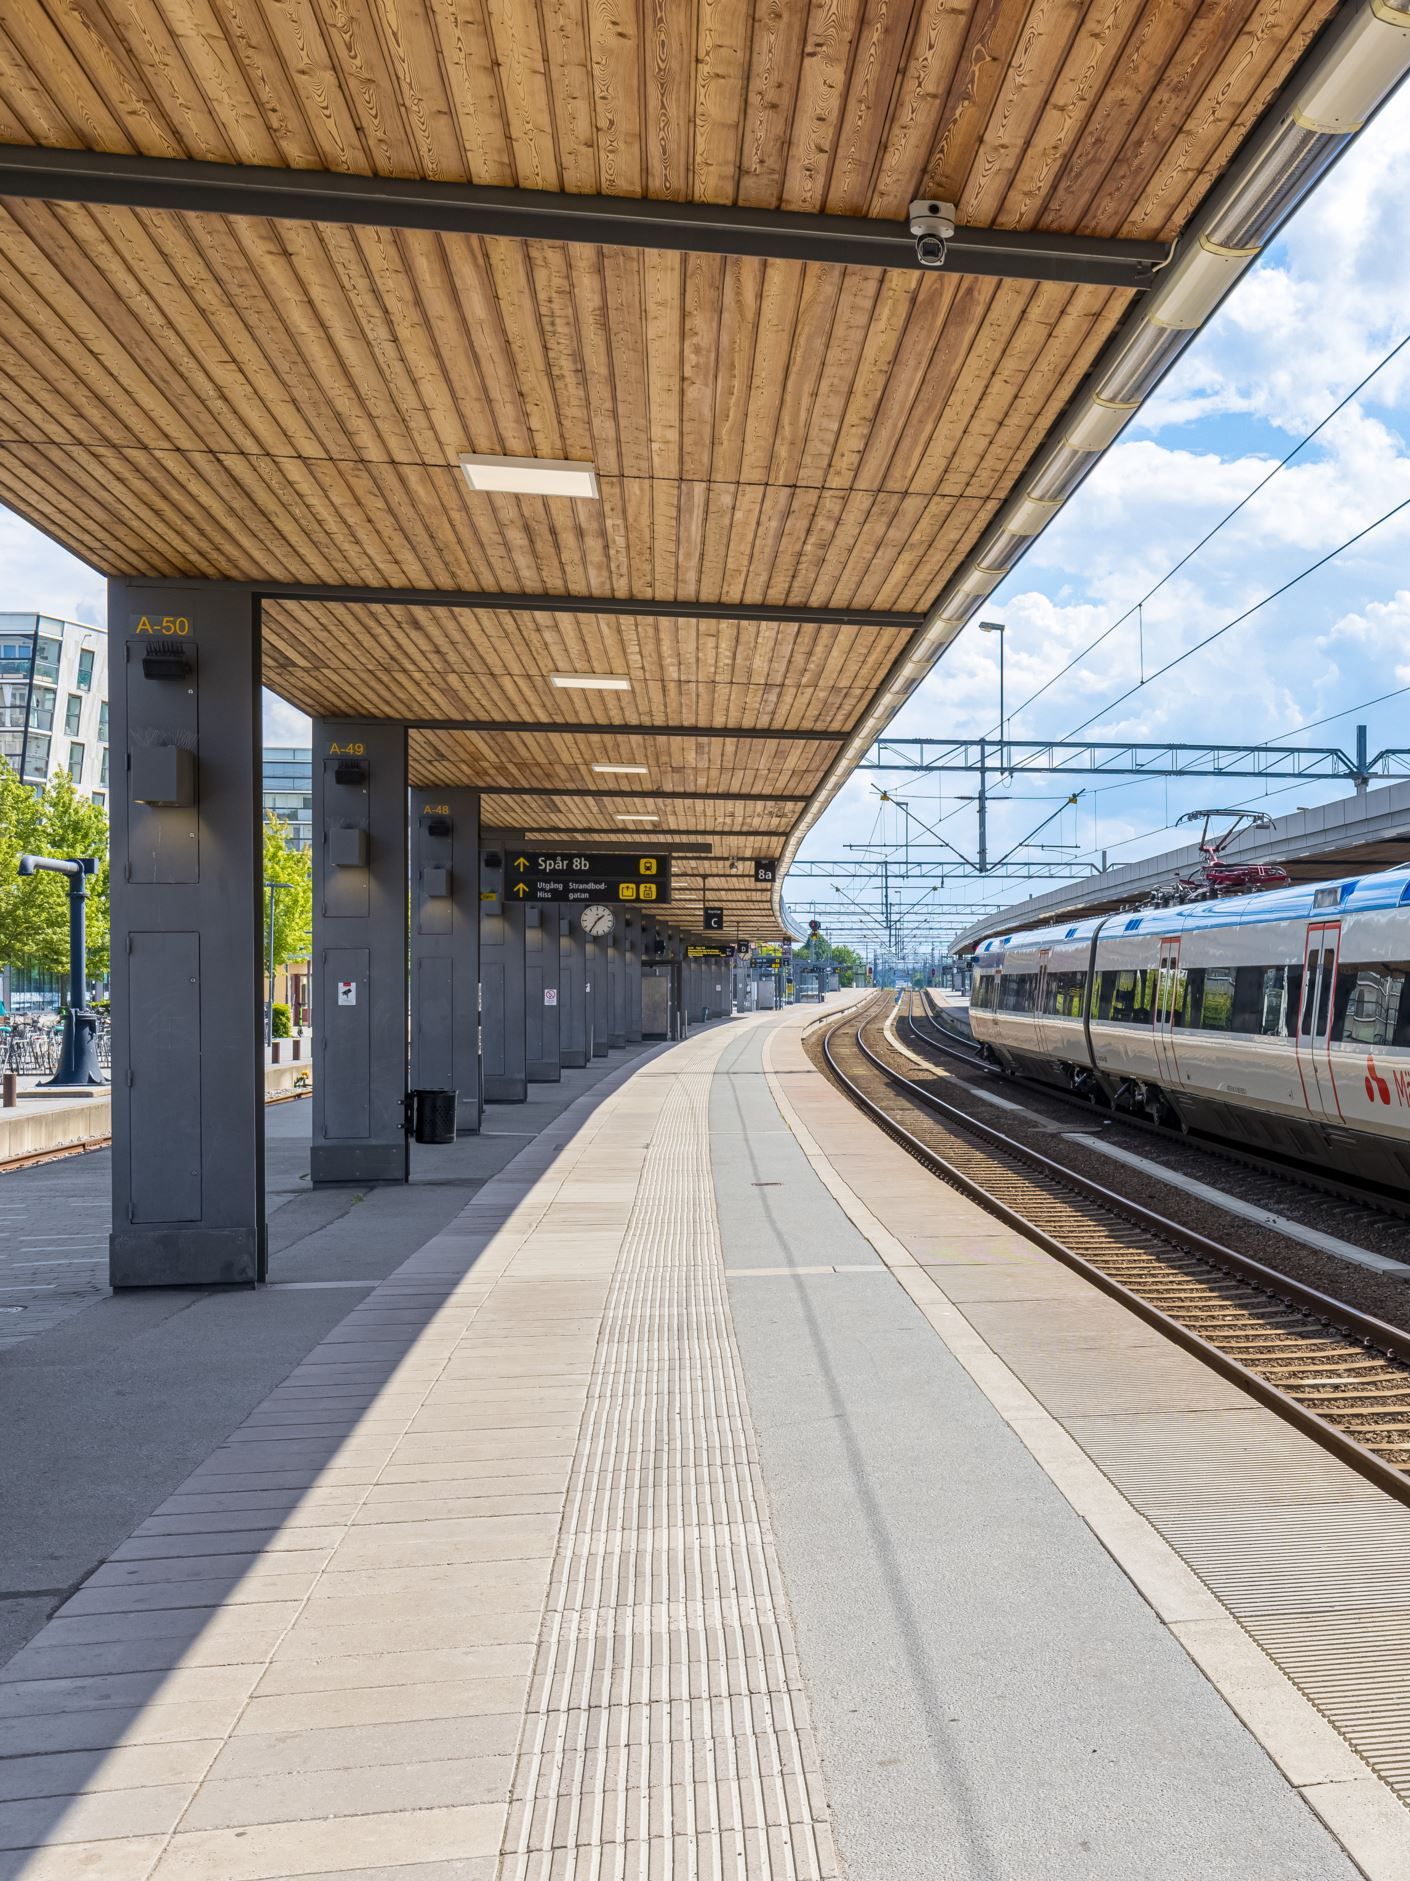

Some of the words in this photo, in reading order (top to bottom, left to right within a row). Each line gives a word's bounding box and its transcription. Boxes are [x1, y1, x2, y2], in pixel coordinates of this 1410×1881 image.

[135, 616, 189, 635] A-50
[329, 743, 365, 755] A-49
[423, 805, 449, 815] A-48
[537, 856, 569, 872] Spår
[572, 857, 590, 870] 8b
[758, 869, 772, 880] 8a
[537, 881, 563, 891] Utgång
[568, 882, 608, 890] Strandbod-
[537, 891, 552, 899] Hiss
[568, 892, 590, 900] gatan
[711, 918, 718, 928] C
